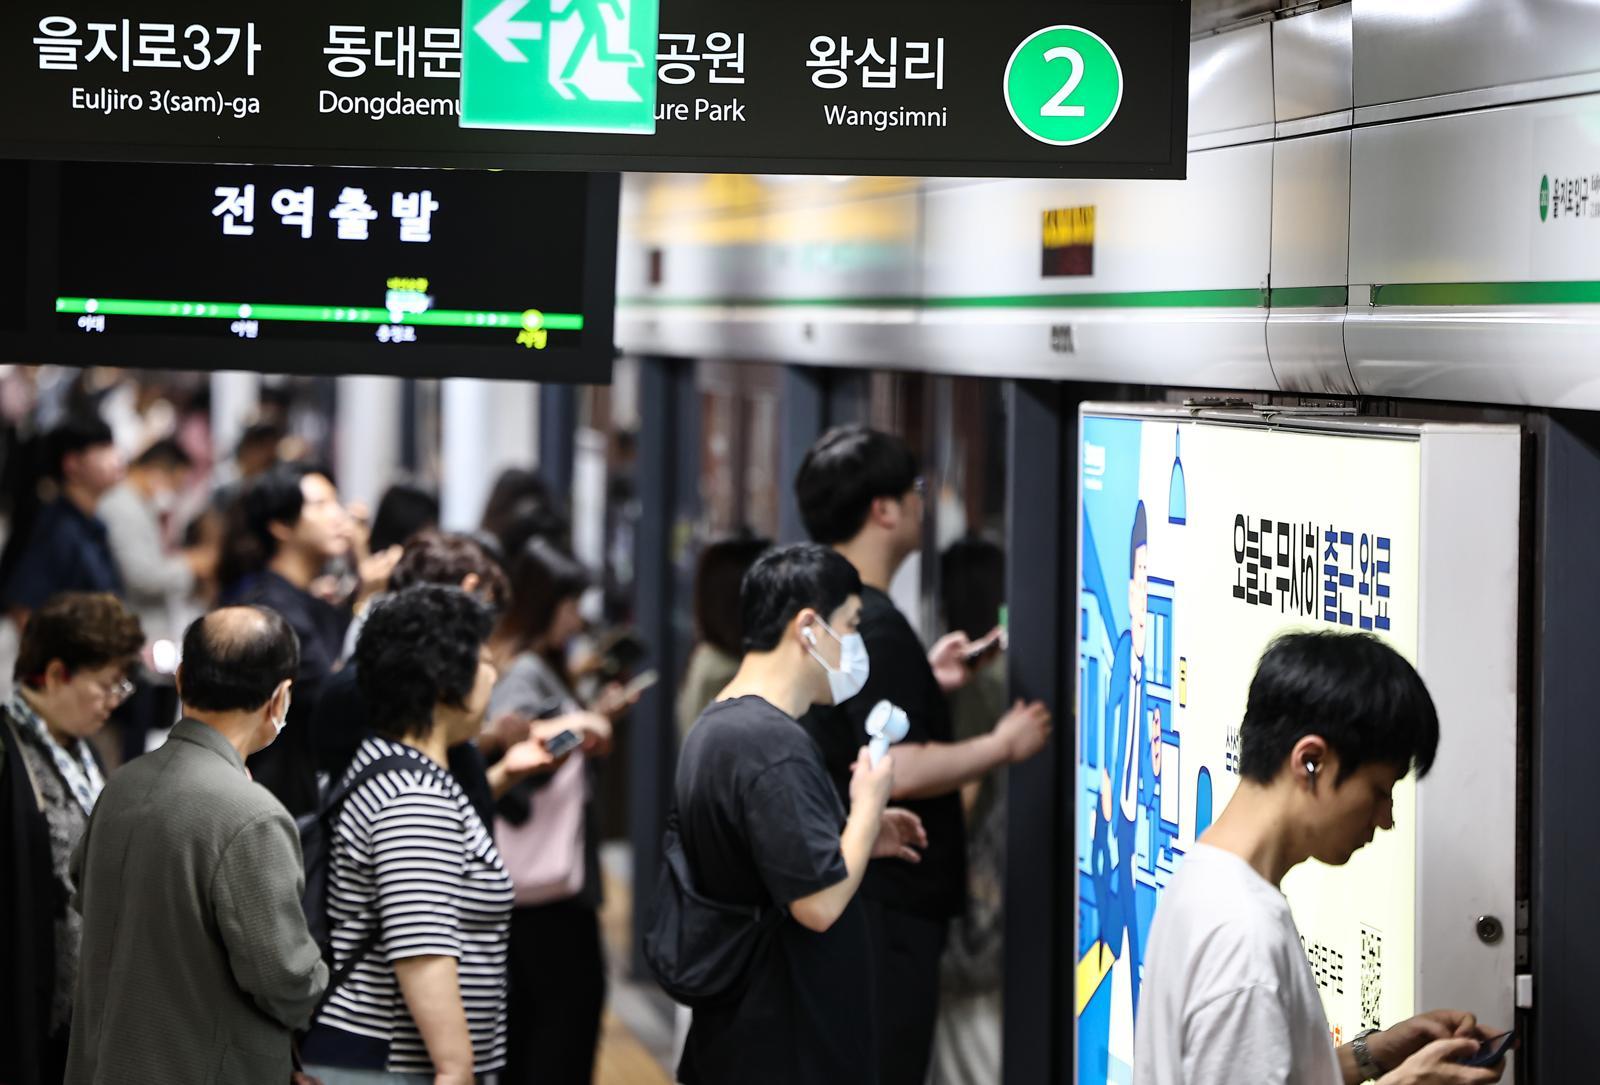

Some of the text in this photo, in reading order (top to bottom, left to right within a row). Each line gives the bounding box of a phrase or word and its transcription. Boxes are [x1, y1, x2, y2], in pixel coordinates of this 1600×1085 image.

[33, 16, 261, 76] 을지로3가
[323, 25, 462, 79] 동대문
[655, 31, 745, 84] 공원
[805, 35, 944, 90] 왕십리
[72, 87, 260, 119] Euljiro 3(sam)-ga
[1039, 46, 1086, 117] 2
[695, 98, 746, 121] Park
[823, 104, 947, 132] Wangsimni
[1552, 177, 1589, 218] 을지로입구
[1232, 513, 1391, 632] 오늘도 무사히 출근 완료
